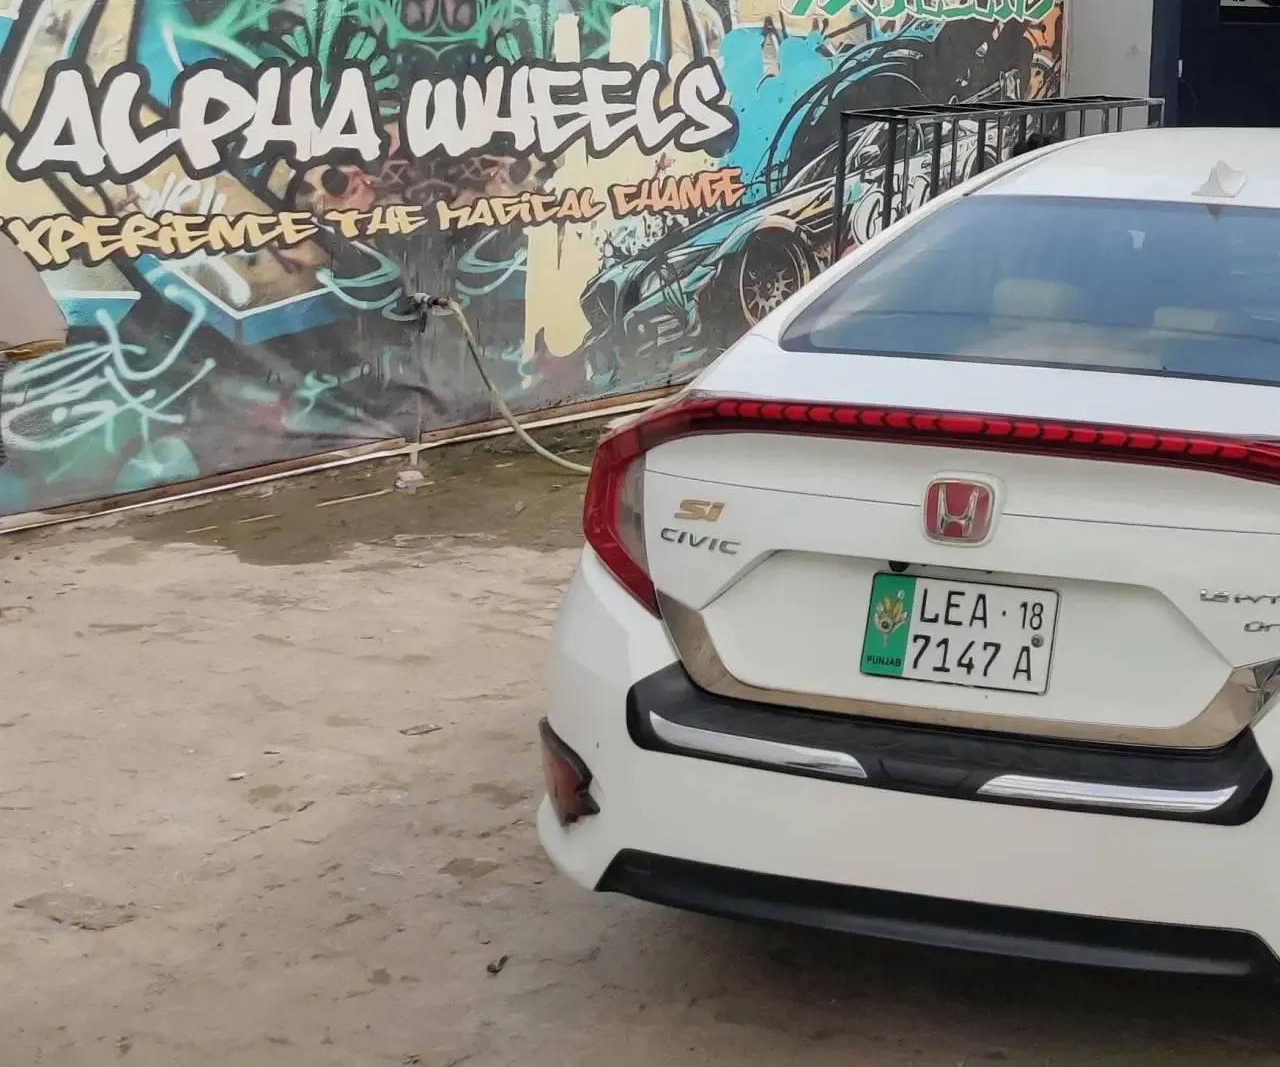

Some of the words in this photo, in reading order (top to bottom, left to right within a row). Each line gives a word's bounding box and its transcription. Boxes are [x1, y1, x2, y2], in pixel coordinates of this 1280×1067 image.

[16, 66, 382, 178] ALPHA
[406, 65, 734, 157] WHEELS
[324, 205, 428, 238] THE
[615, 167, 747, 215] CHANGE
[660, 527, 742, 555] CIVIC
[919, 588, 988, 629] LEA
[1019, 601, 1045, 631] 18
[865, 654, 902, 668] PUNJAB
[912, 634, 1001, 677] 7147
[1012, 645, 1032, 681] A
